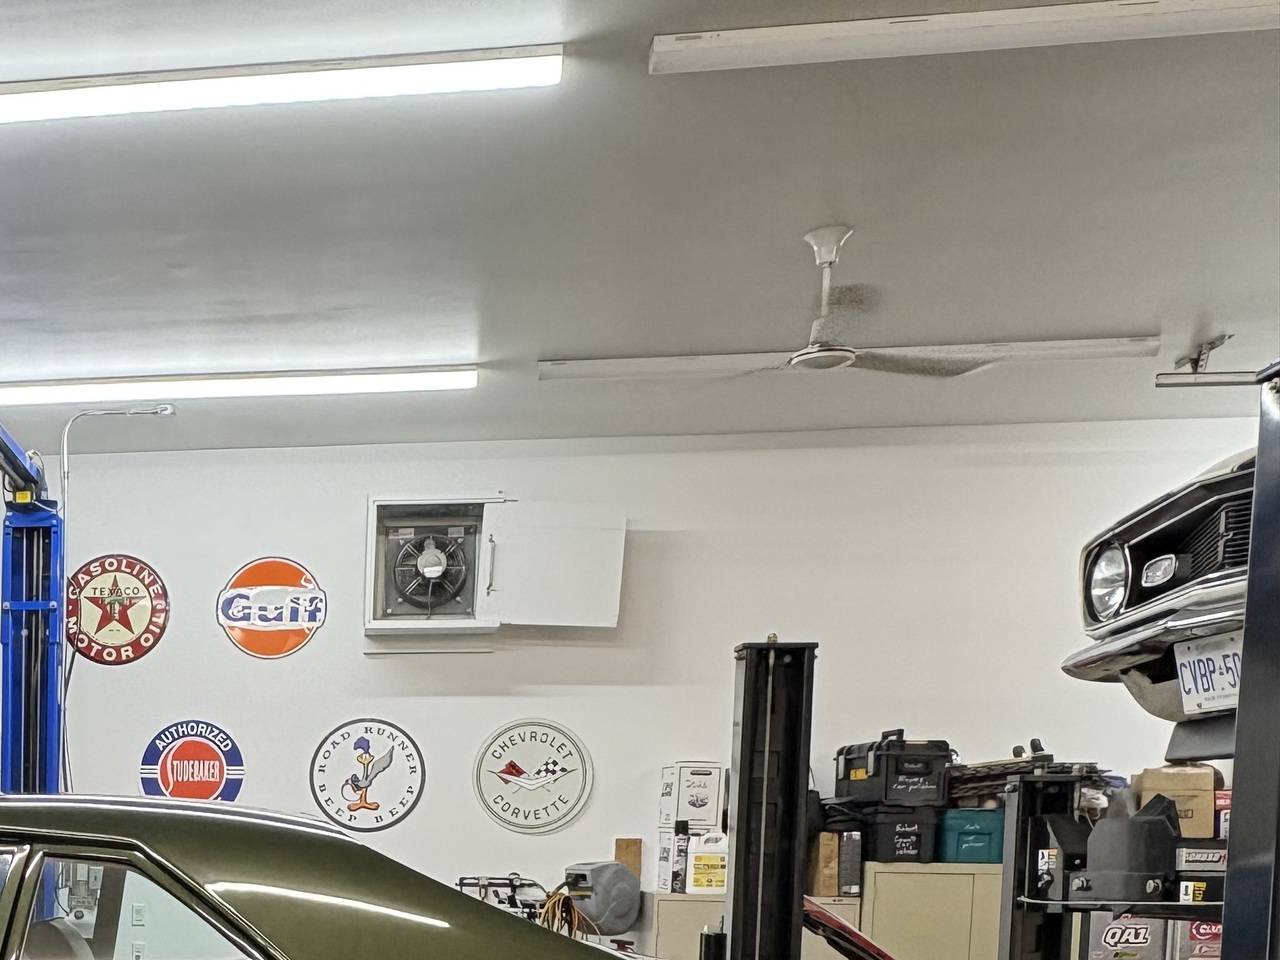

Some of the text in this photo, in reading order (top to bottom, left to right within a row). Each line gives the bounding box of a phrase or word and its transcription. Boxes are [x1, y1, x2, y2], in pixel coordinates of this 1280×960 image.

[68, 558, 163, 600] GASOLINE
[91, 586, 140, 598] TEXACO
[221, 593, 324, 623] Gulf
[67, 612, 166, 661] MOTOR OIL
[1180, 657, 1217, 696] CVBP
[155, 722, 232, 752] AUTHORIZED
[317, 726, 417, 775] ROAD RUNNER
[491, 731, 574, 760] CHEVROLET
[319, 784, 415, 823] BEEP BEEP
[492, 794, 569, 820] CORVETTE
[1104, 926, 1150, 947] QA1
